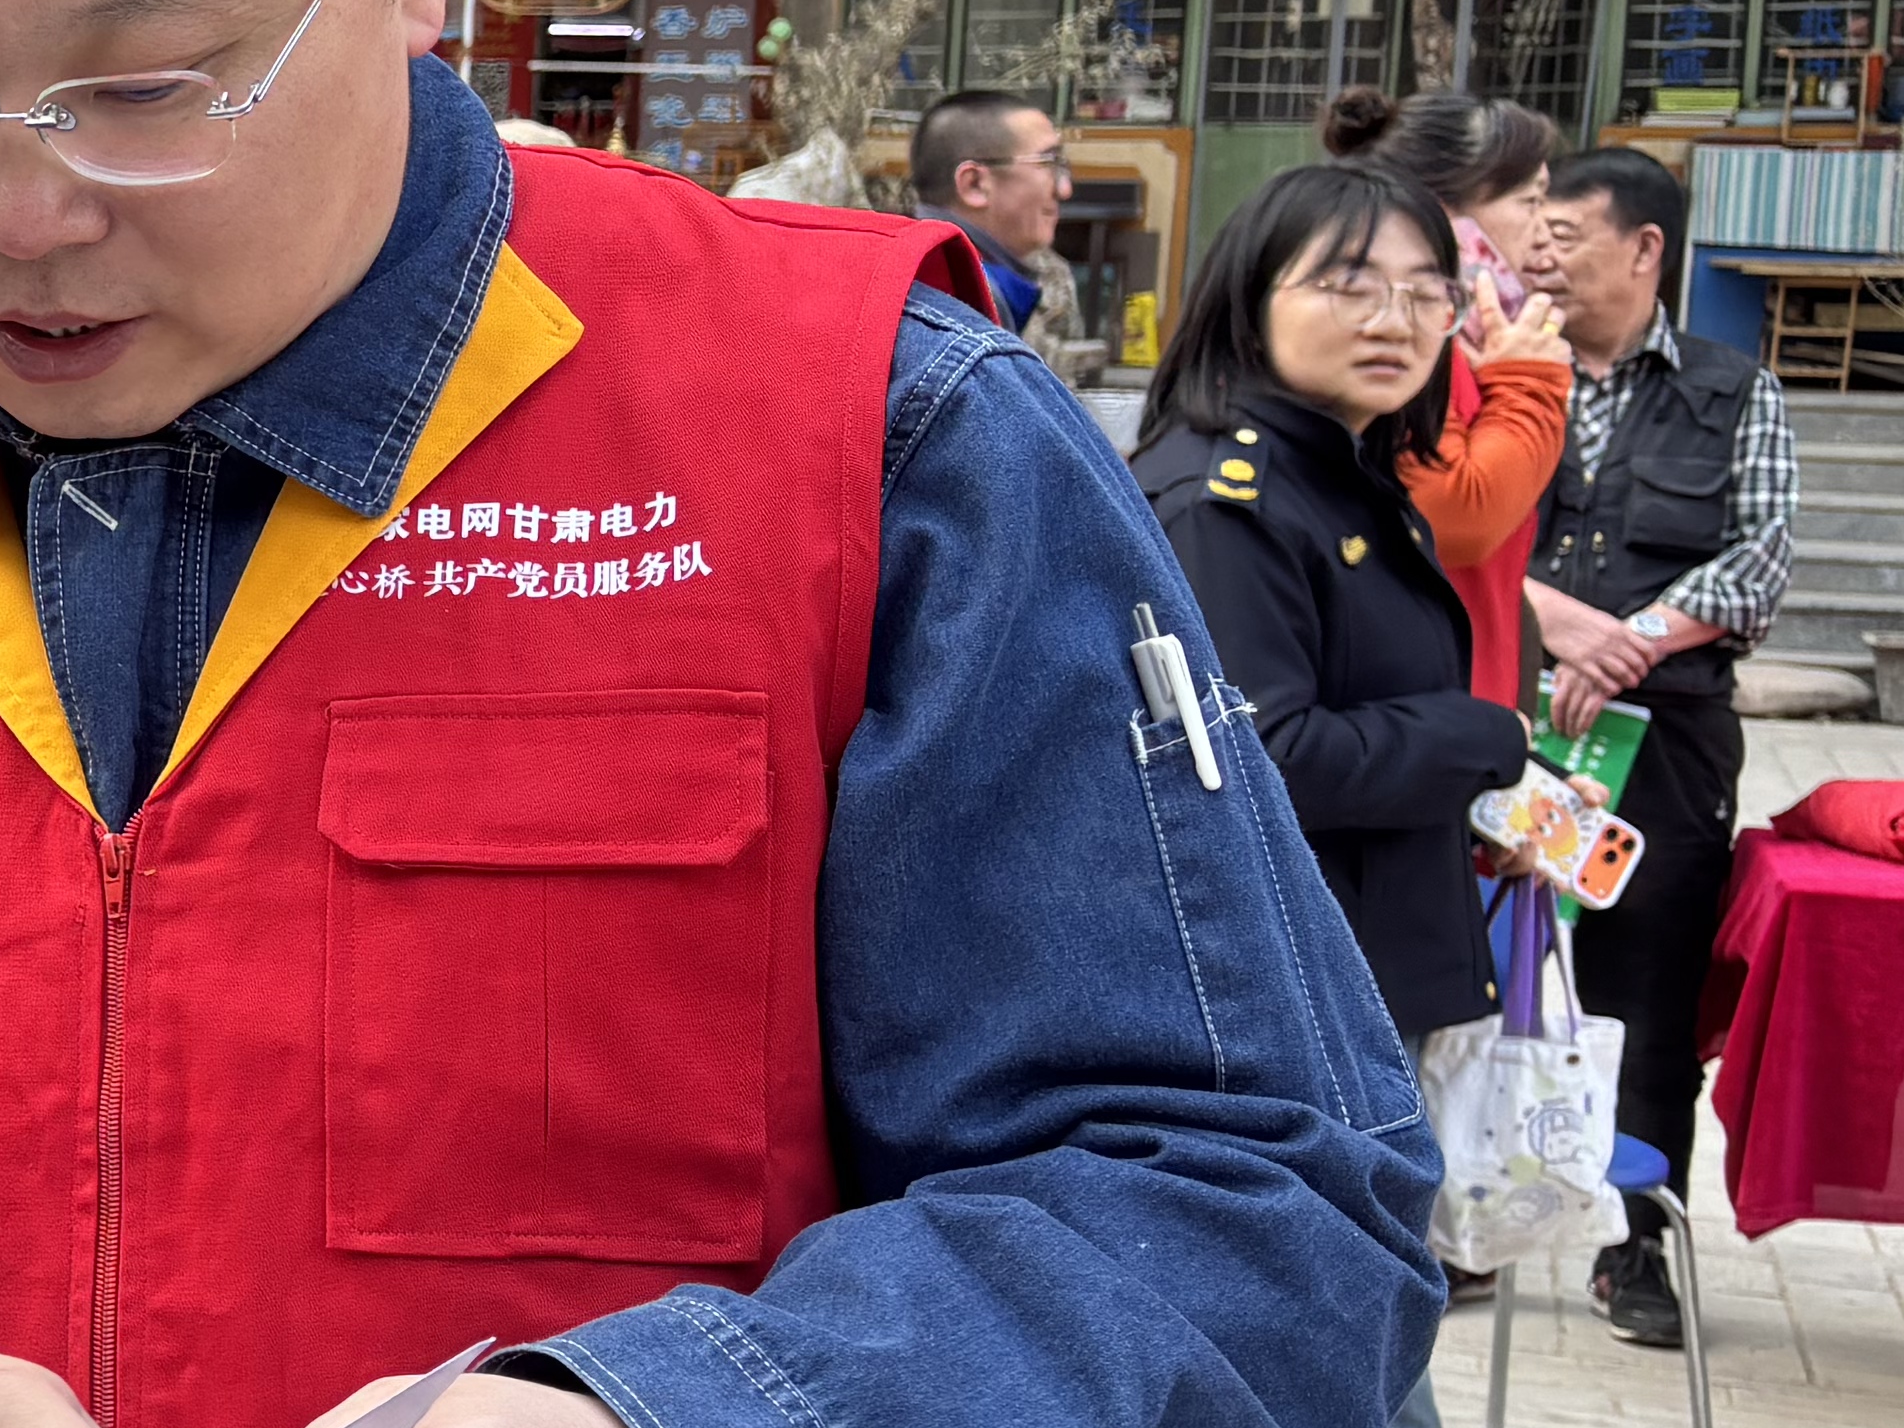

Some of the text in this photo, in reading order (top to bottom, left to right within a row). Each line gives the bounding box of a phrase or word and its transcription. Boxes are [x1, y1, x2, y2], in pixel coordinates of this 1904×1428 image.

[317, 539, 714, 600] 心桥 共产党员服务队
